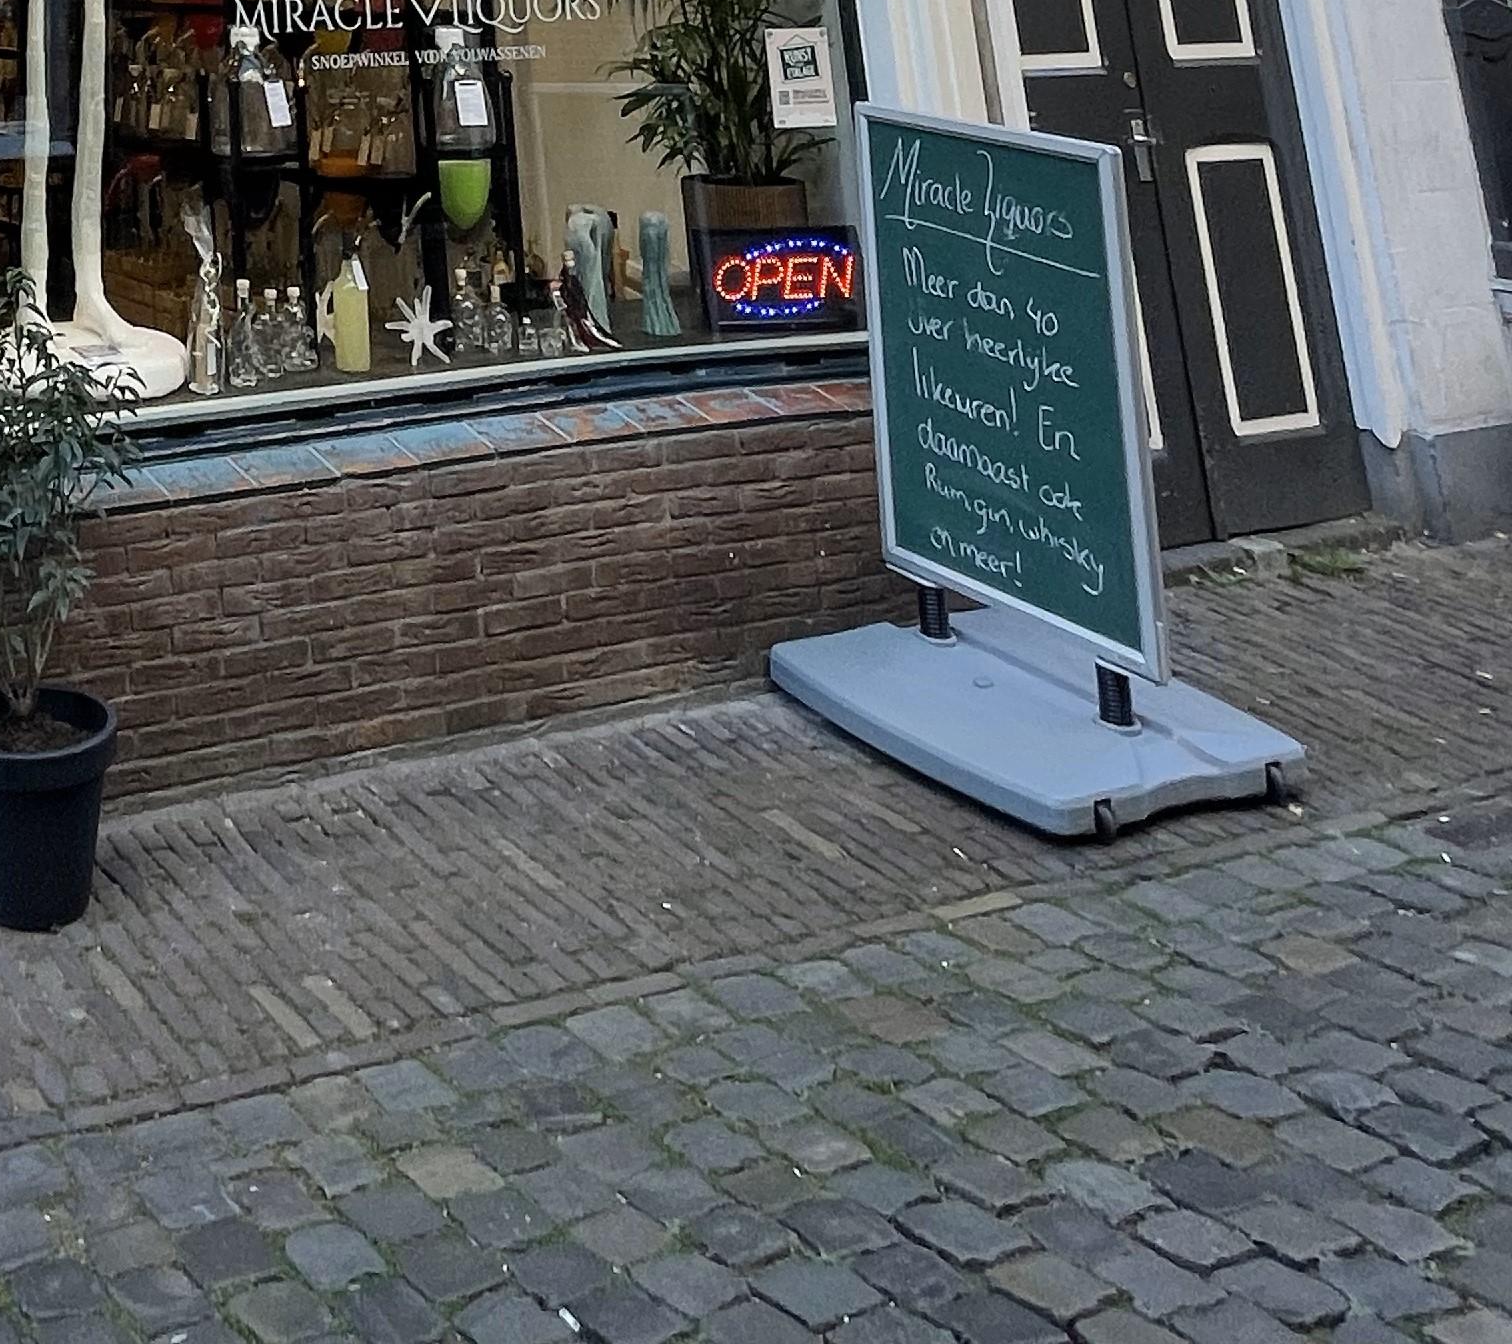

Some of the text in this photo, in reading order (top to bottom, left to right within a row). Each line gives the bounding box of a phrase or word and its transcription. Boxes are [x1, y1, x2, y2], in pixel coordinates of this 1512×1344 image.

[311, 50, 409, 70] SNOEPWINKEL
[453, 45, 546, 62] VOLWASSENEN
[880, 136, 1074, 275] Miracle Liquors
[713, 255, 855, 302] OPEN
[902, 246, 1059, 336] Meer dan 40
[912, 346, 1081, 461] likeuren! En
[1039, 481, 1083, 522] ook
[959, 540, 1023, 588] meer!
[1018, 515, 1104, 596] whisky
